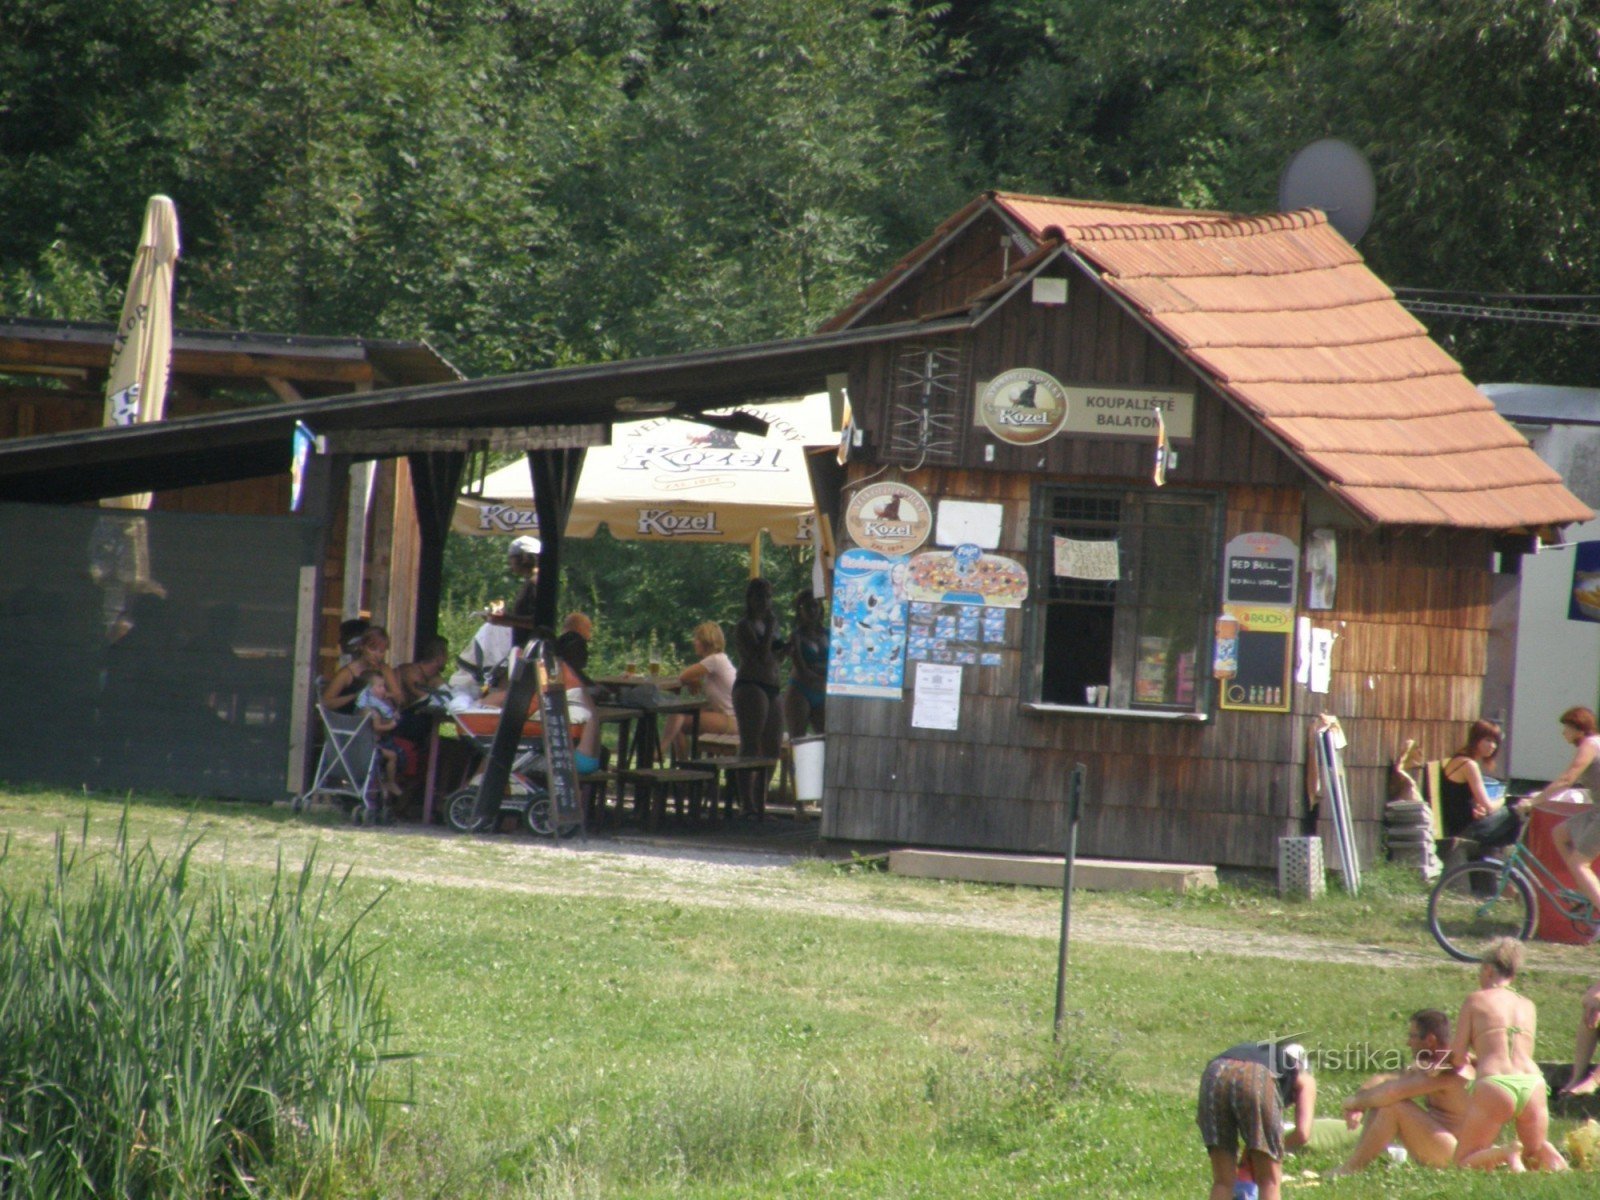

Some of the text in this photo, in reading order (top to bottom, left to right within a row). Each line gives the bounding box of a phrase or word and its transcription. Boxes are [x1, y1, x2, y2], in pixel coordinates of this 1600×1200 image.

[1086, 396, 1175, 412] KOUPALIŠTĚ
[999, 408, 1052, 427] Kozel
[637, 508, 724, 537] Kozel
[864, 521, 917, 539] Kozel
